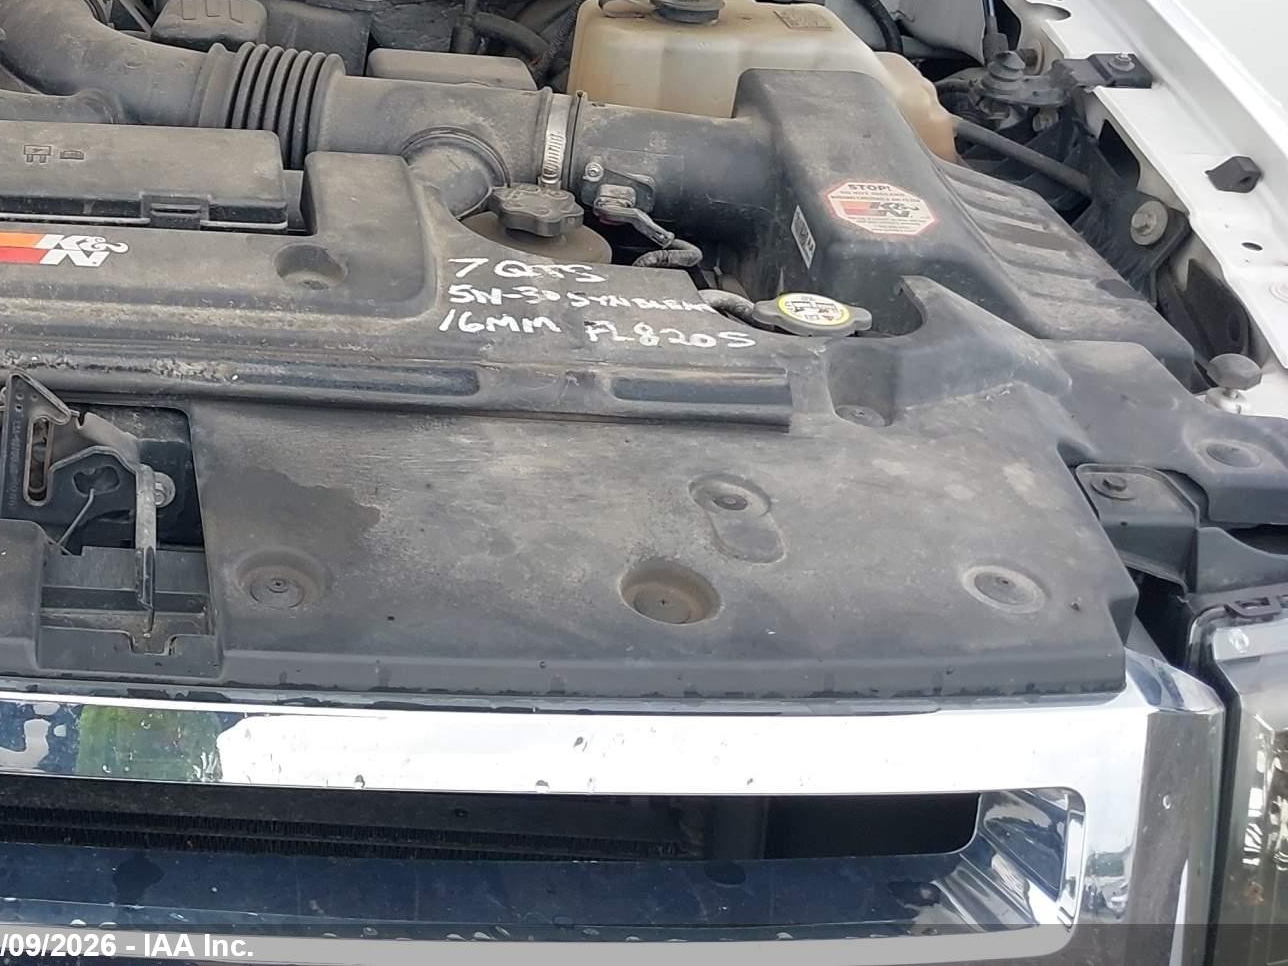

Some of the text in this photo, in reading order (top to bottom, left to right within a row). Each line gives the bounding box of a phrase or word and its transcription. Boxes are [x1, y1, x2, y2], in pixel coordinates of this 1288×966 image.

[35, 234, 129, 267] K&N
[447, 257, 608, 283] 7 QTS
[438, 308, 562, 334] 16MM
